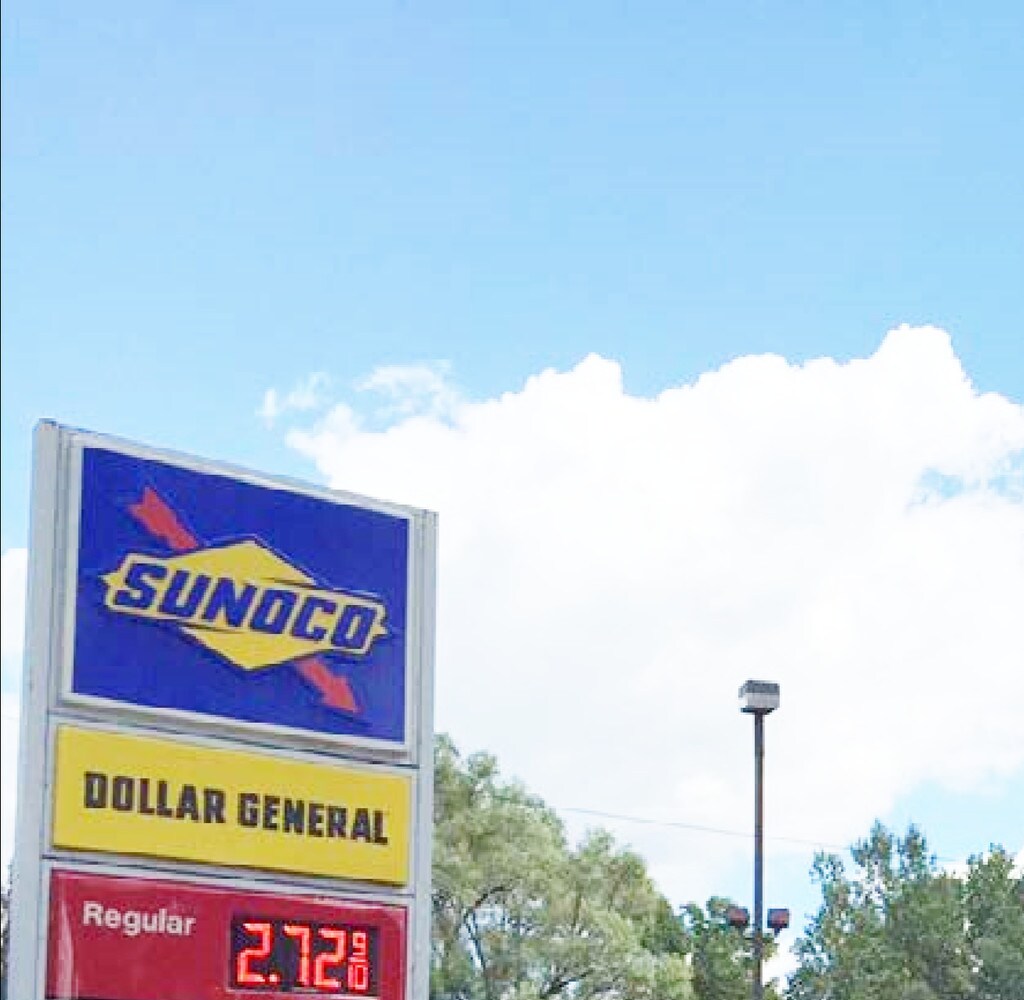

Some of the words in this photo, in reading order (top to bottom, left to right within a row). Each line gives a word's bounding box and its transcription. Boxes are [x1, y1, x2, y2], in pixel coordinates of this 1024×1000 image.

[115, 563, 374, 650] SUNOCO
[84, 770, 226, 824] DOLLAR
[236, 792, 389, 846] GENERAL
[82, 900, 196, 937] Regular
[236, 922, 347, 989] 2.72
